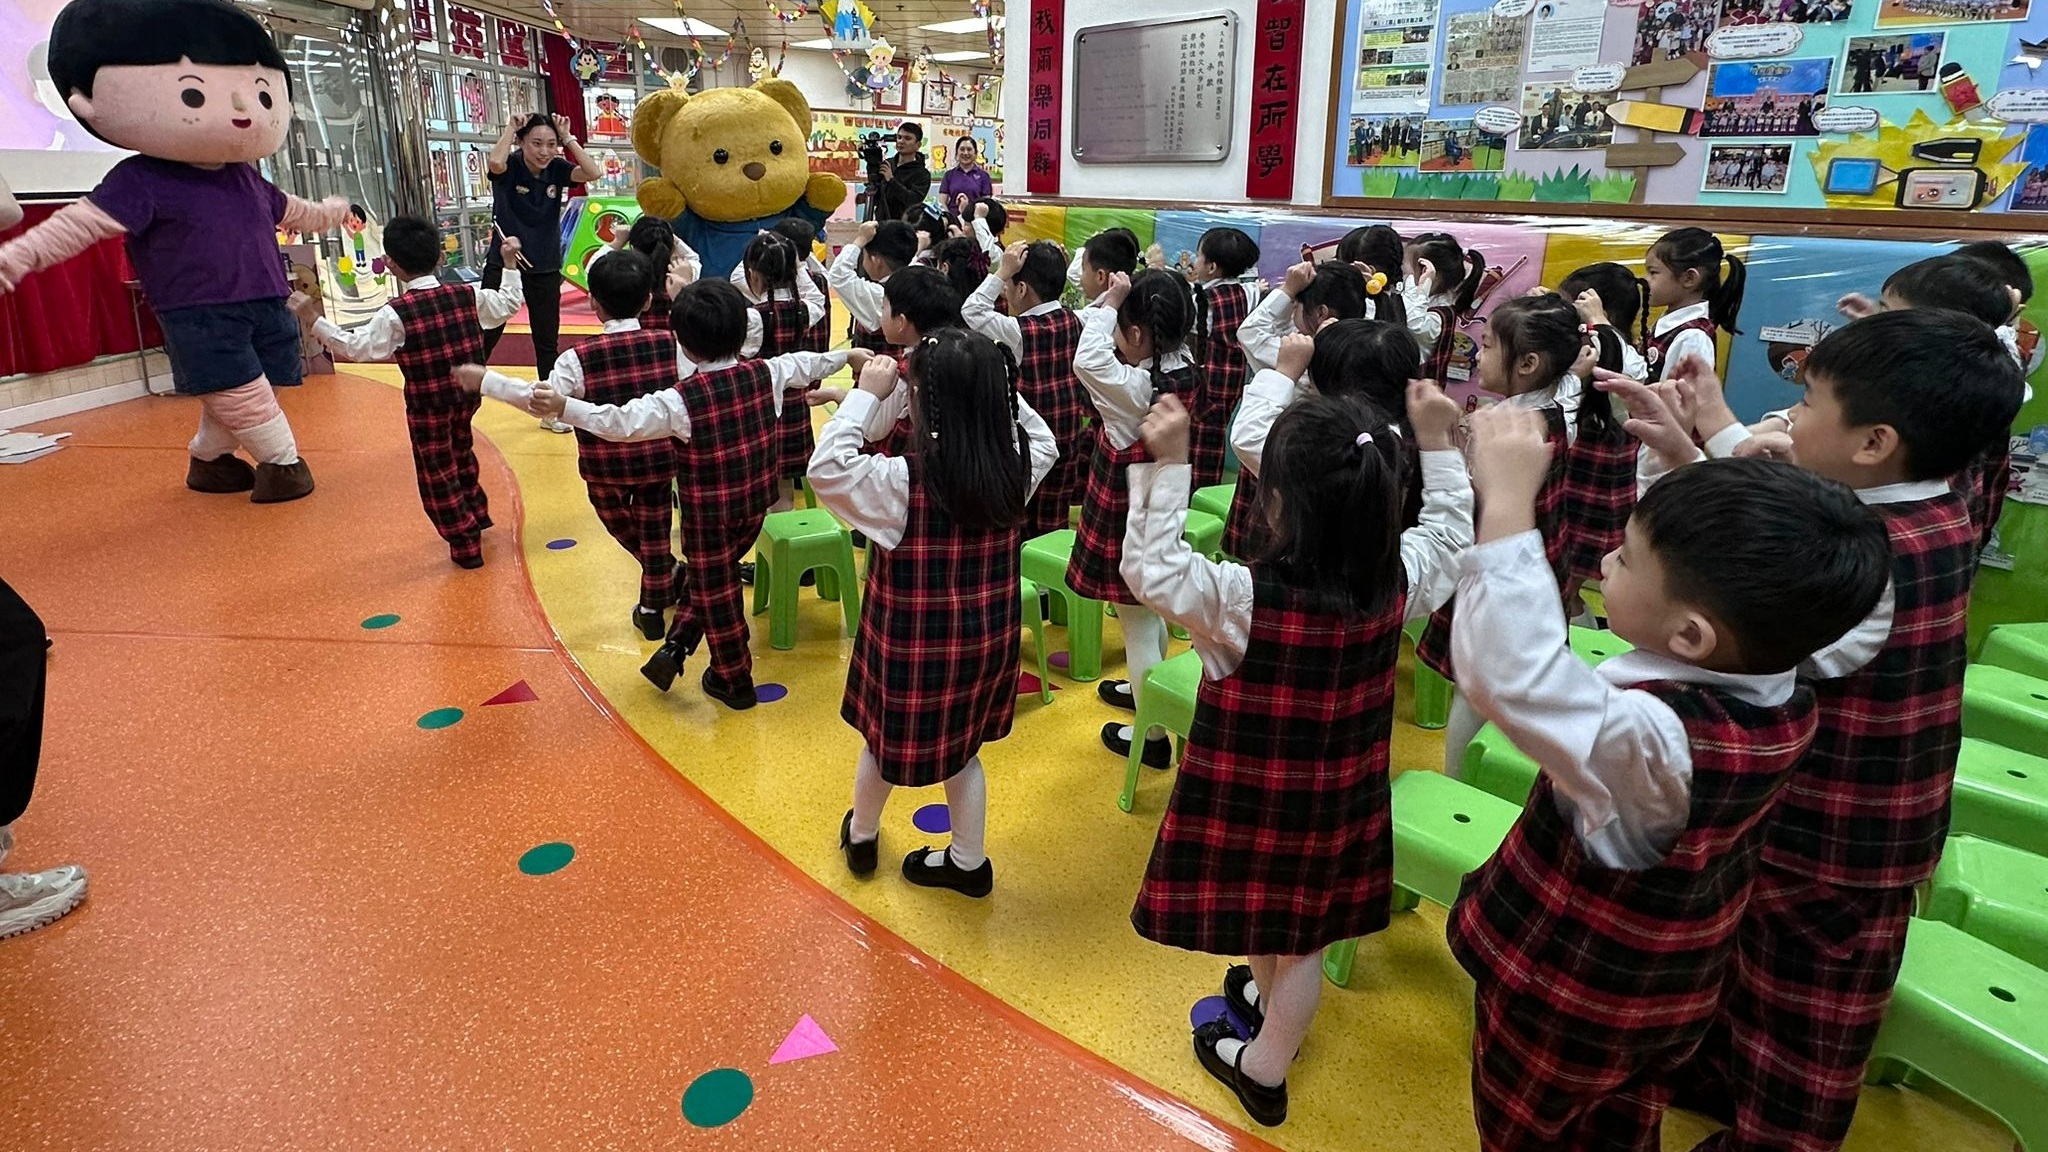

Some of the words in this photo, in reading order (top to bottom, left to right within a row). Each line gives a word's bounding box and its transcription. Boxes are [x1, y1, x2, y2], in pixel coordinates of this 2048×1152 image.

[1032, 8, 1056, 177] 我爾樂同群
[1256, 0, 1292, 178] 智在所學
